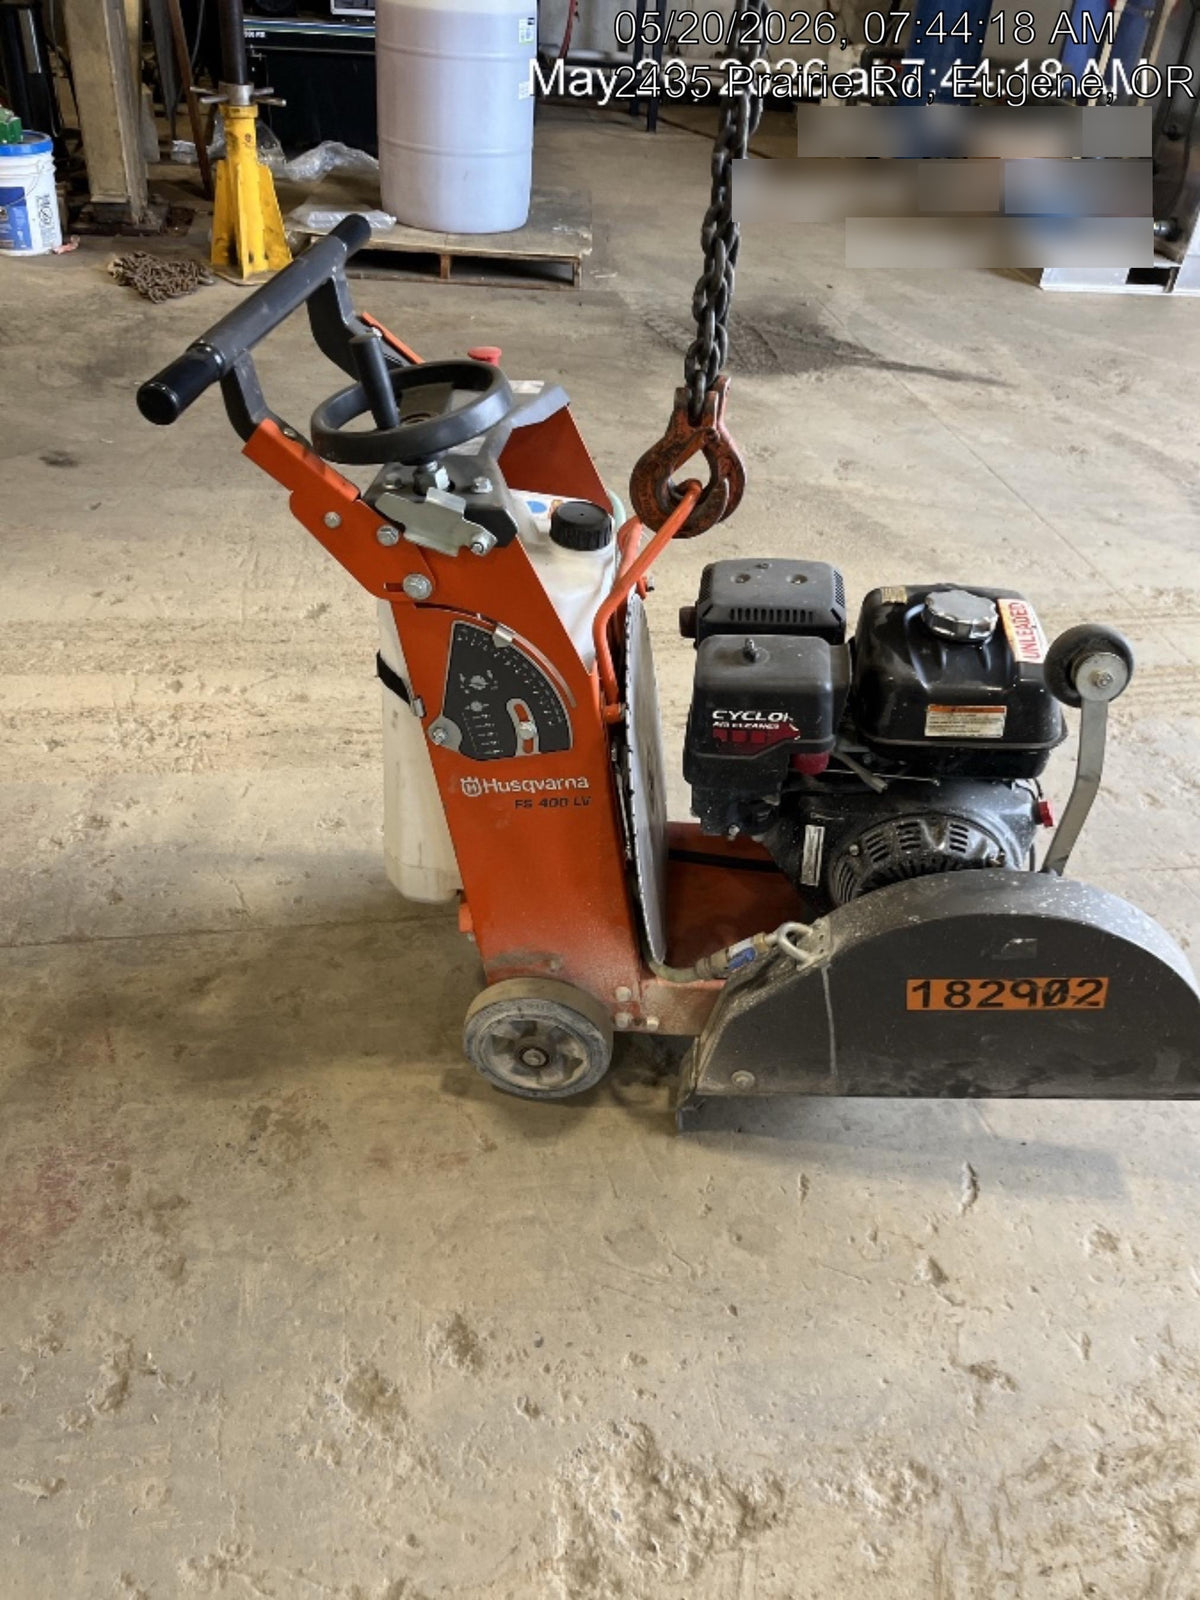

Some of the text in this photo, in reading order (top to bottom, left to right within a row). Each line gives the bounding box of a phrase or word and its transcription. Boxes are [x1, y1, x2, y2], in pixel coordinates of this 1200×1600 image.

[1008, 602, 1041, 659] UNLEADED
[483, 776, 590, 794] Husqvarna
[515, 796, 592, 809] FS 400 LV
[911, 978, 1105, 1008] 182902
